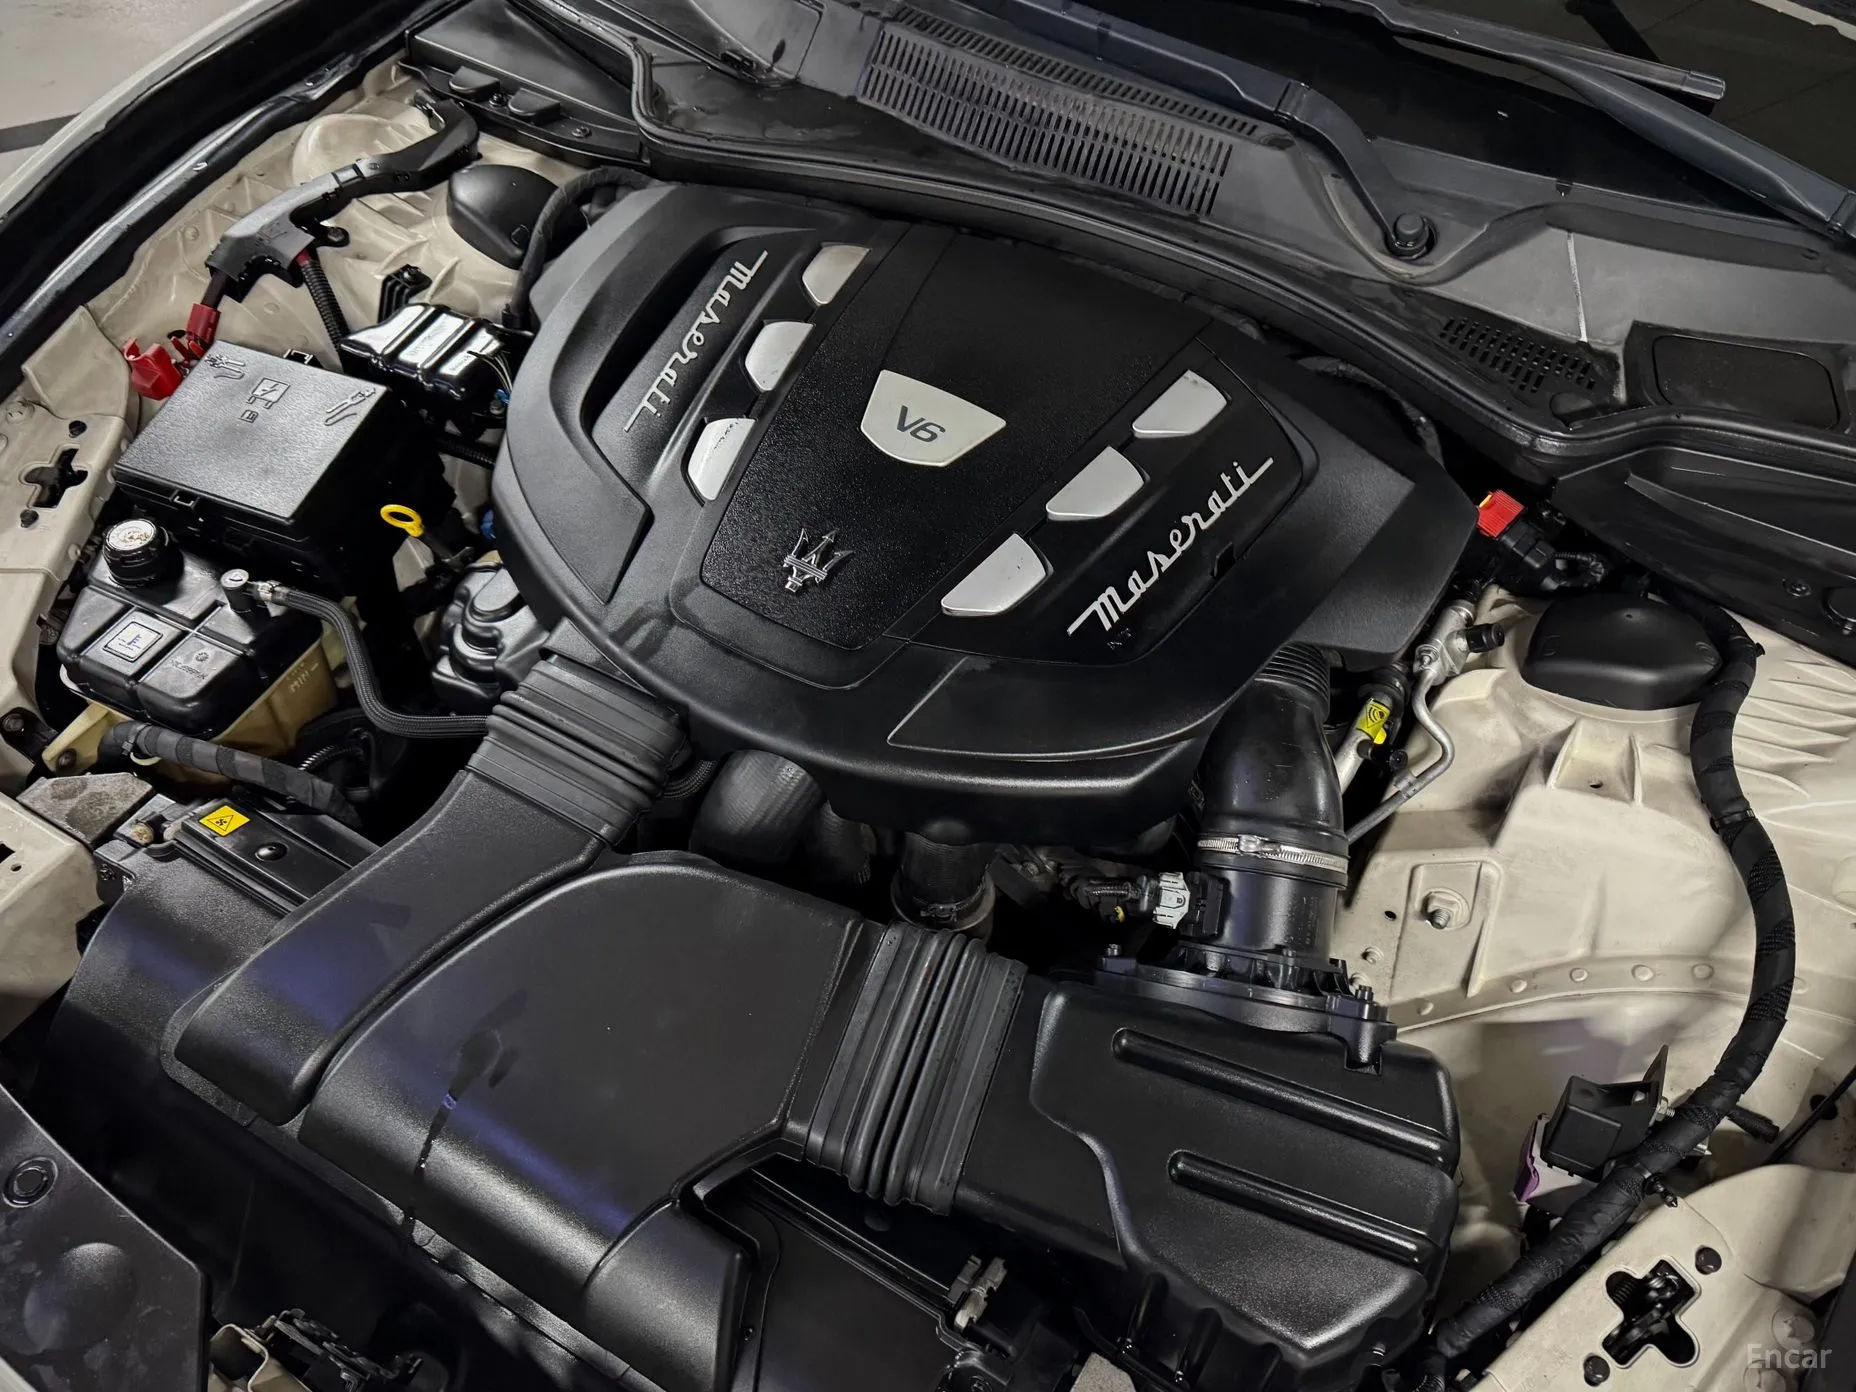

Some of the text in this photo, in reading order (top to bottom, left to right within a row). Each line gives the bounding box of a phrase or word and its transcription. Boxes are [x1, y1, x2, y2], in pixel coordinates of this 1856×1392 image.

[623, 250, 769, 432] Maserati
[897, 405, 945, 442] V6
[1066, 457, 1274, 635] Maserati
